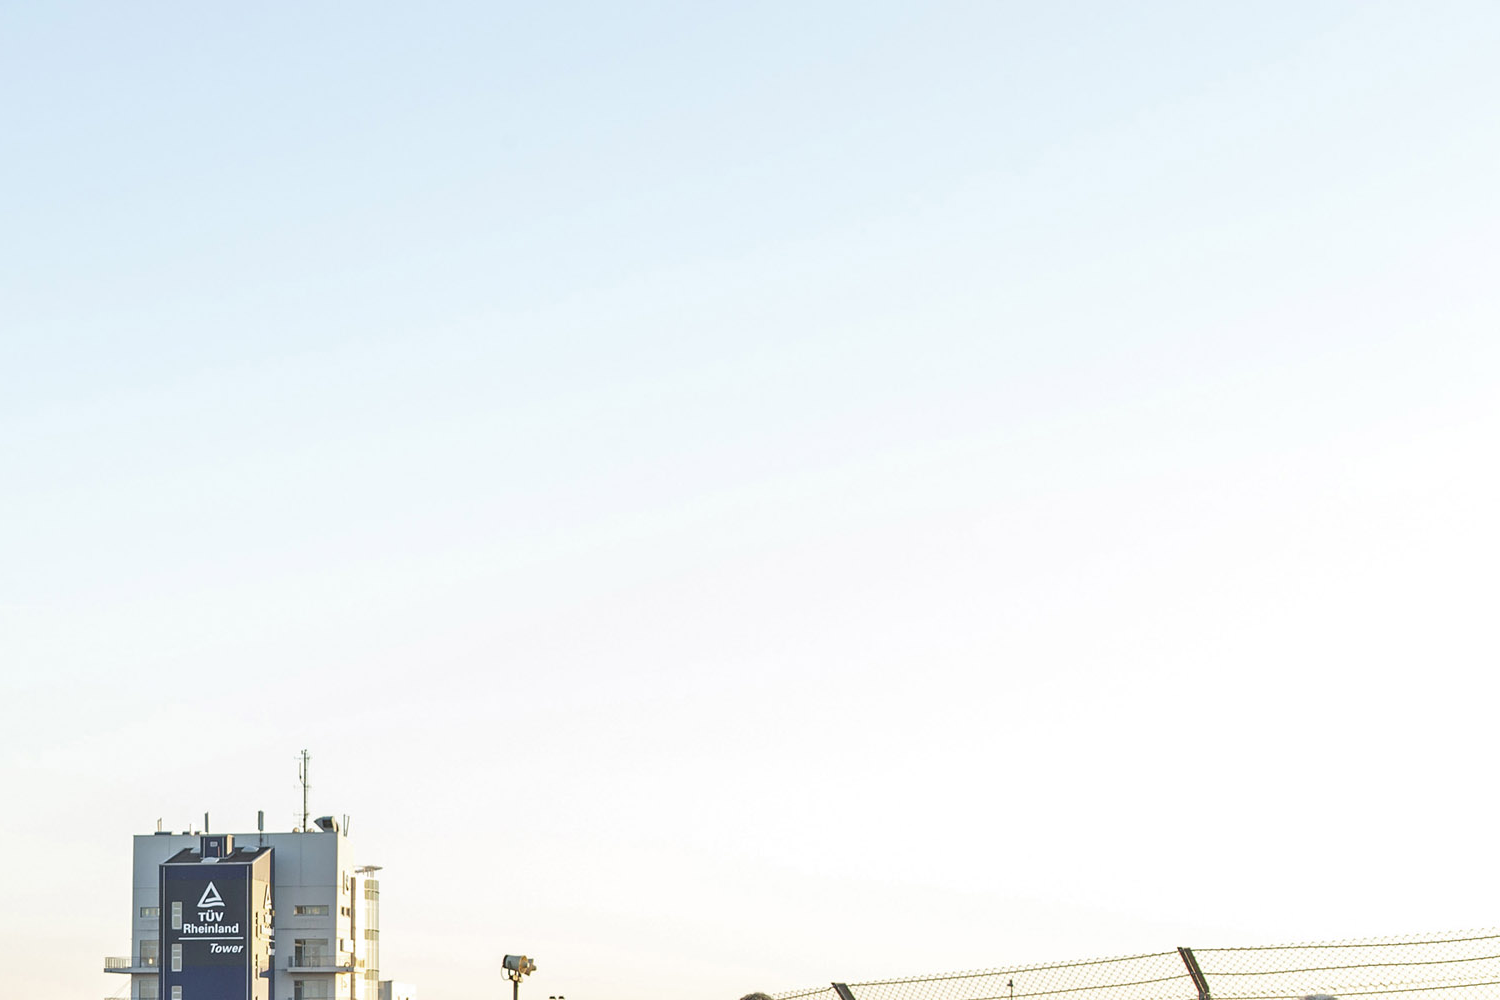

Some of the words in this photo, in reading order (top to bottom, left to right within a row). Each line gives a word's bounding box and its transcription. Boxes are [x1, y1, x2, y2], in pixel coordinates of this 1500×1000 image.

[197, 909, 224, 922] TÜV
[183, 922, 240, 935] Rheinland
[209, 943, 244, 954] Tower
